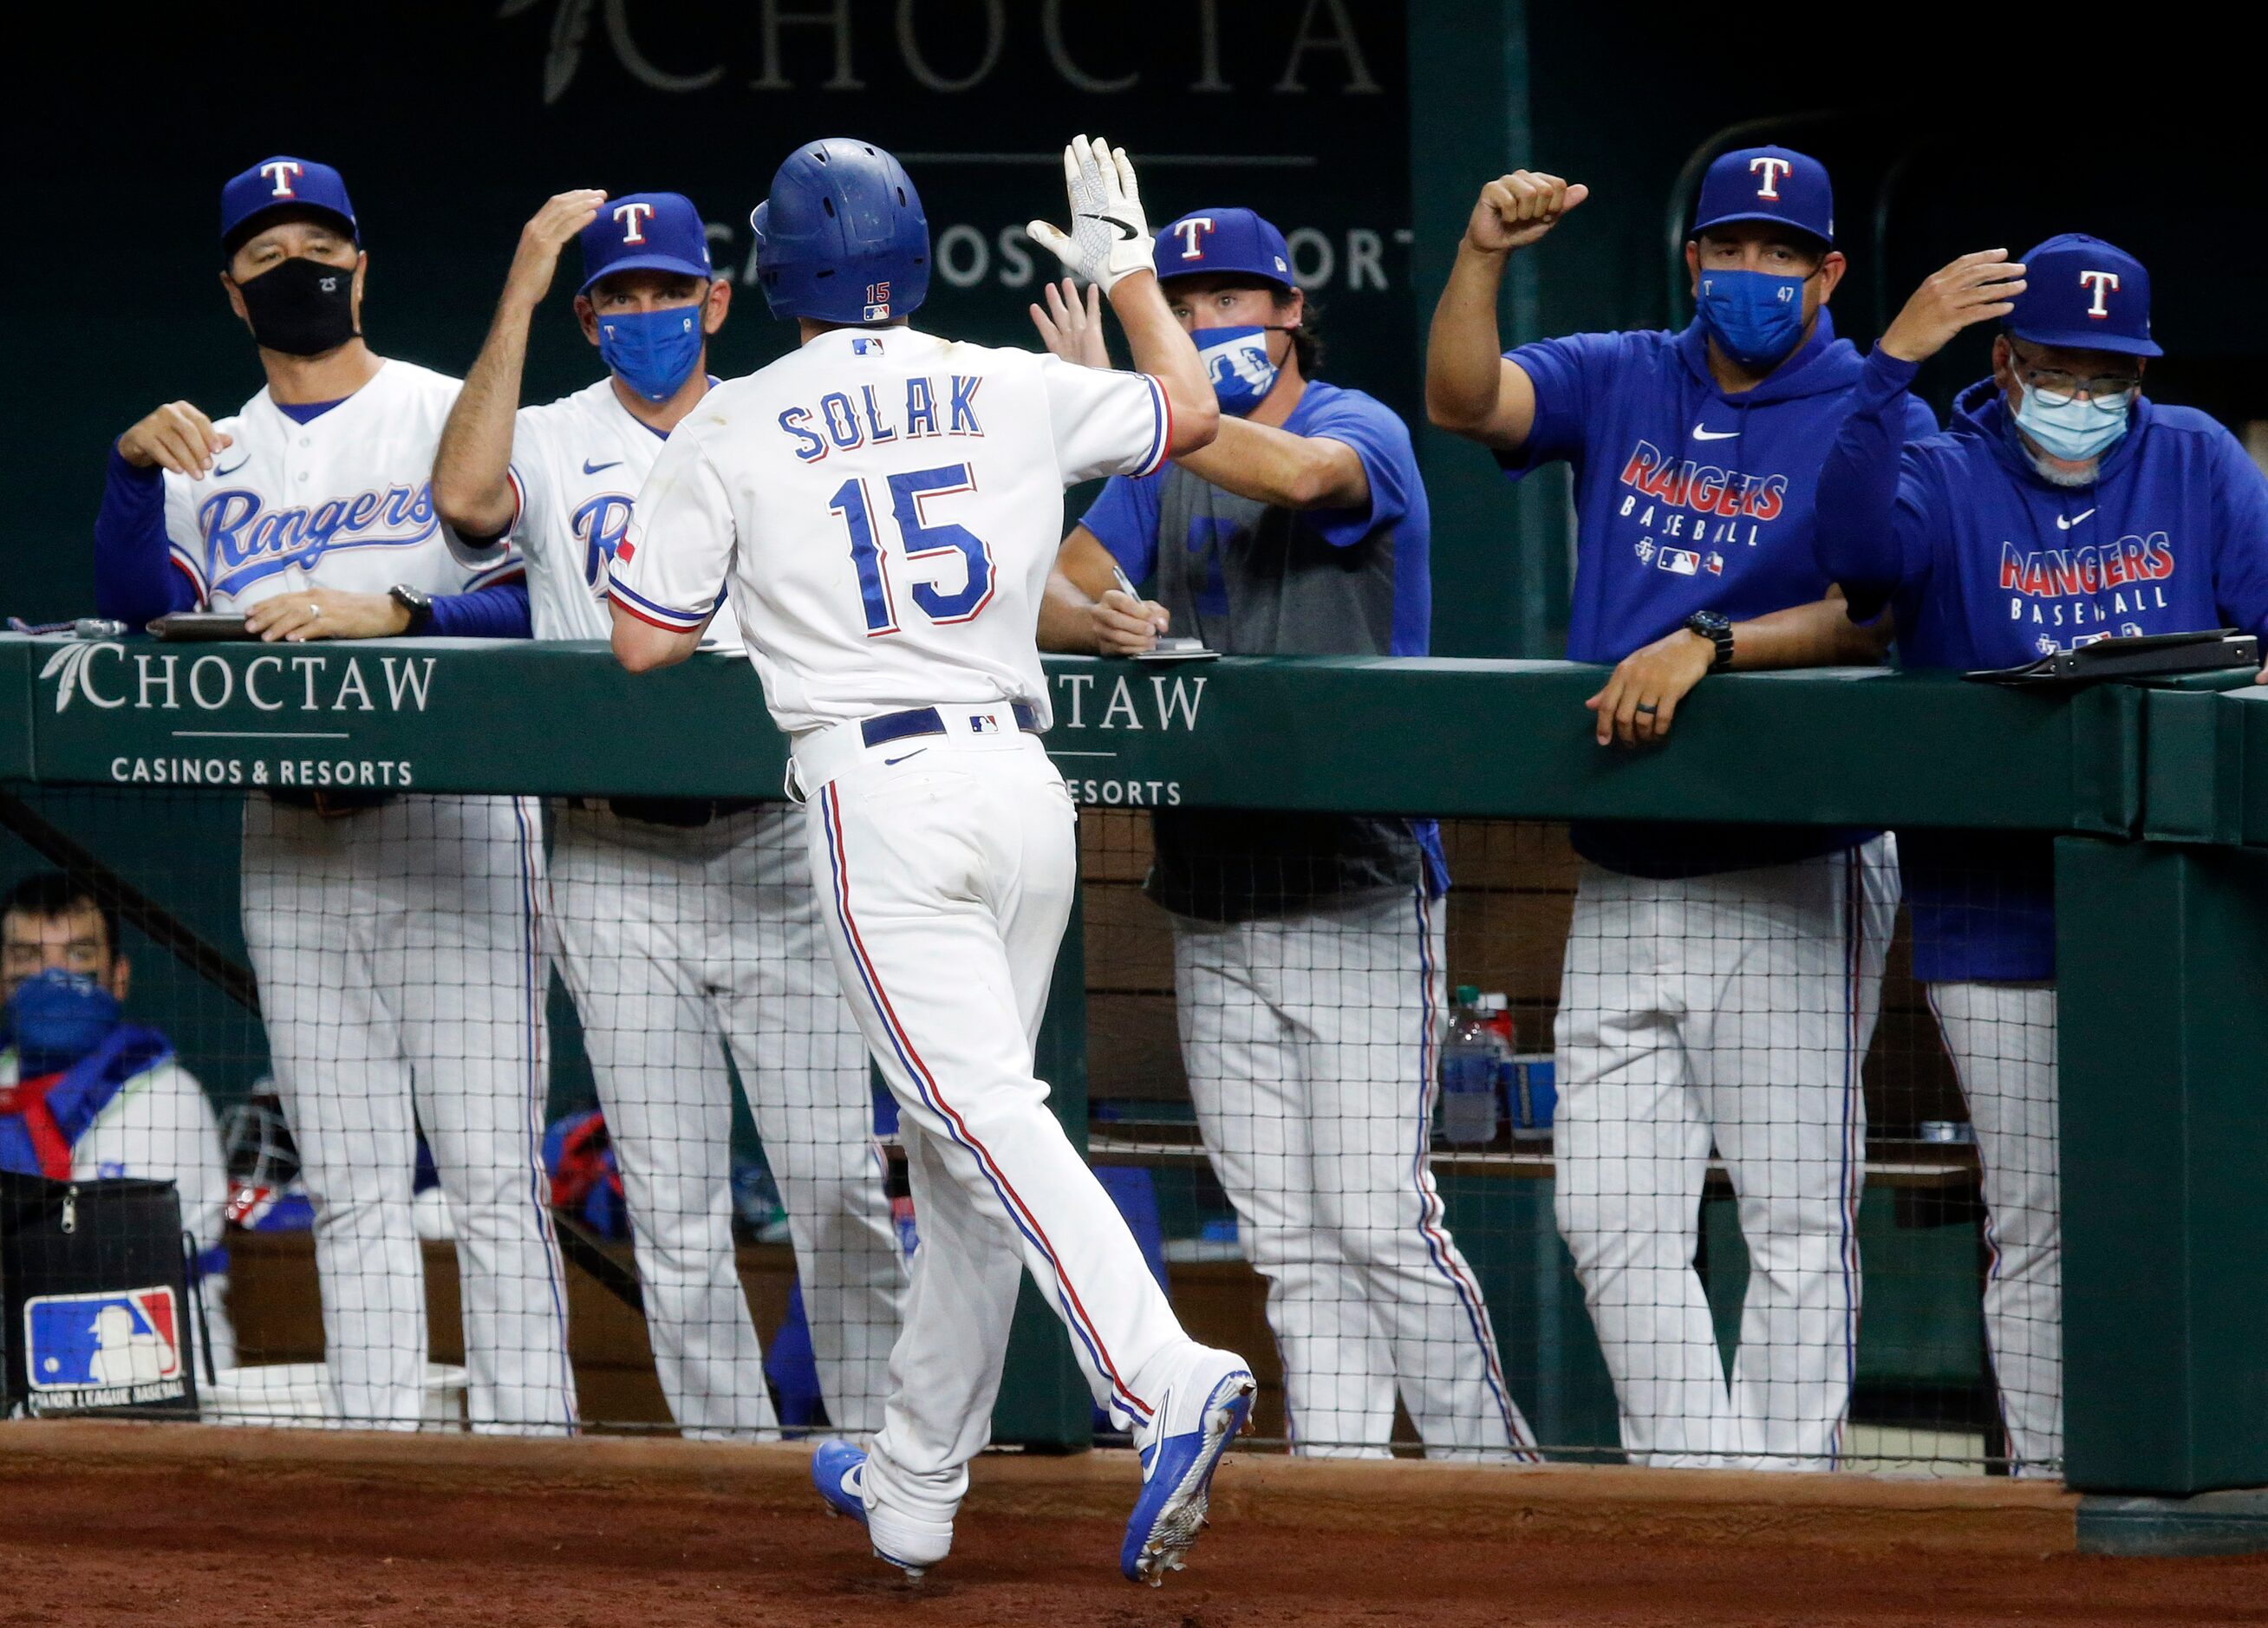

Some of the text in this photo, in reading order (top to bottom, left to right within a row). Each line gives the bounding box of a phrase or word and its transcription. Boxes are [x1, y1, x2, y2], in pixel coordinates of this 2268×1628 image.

[261, 161, 303, 199] T
[1750, 157, 1793, 201] T
[613, 203, 655, 245] T
[1174, 218, 1215, 262] T
[866, 282, 890, 303] 15
[1777, 286, 1795, 303] 47
[2081, 270, 2121, 319] T
[778, 374, 986, 464] SOLAK
[825, 461, 997, 638] 15
[1999, 531, 2175, 598] RANGERS
[78, 641, 437, 713] CHOCTAW
[110, 757, 413, 787] CASINOS & RESORTS
[1066, 778, 1182, 806] ESORTS
[76, 1386, 131, 1408] LEAGUE
